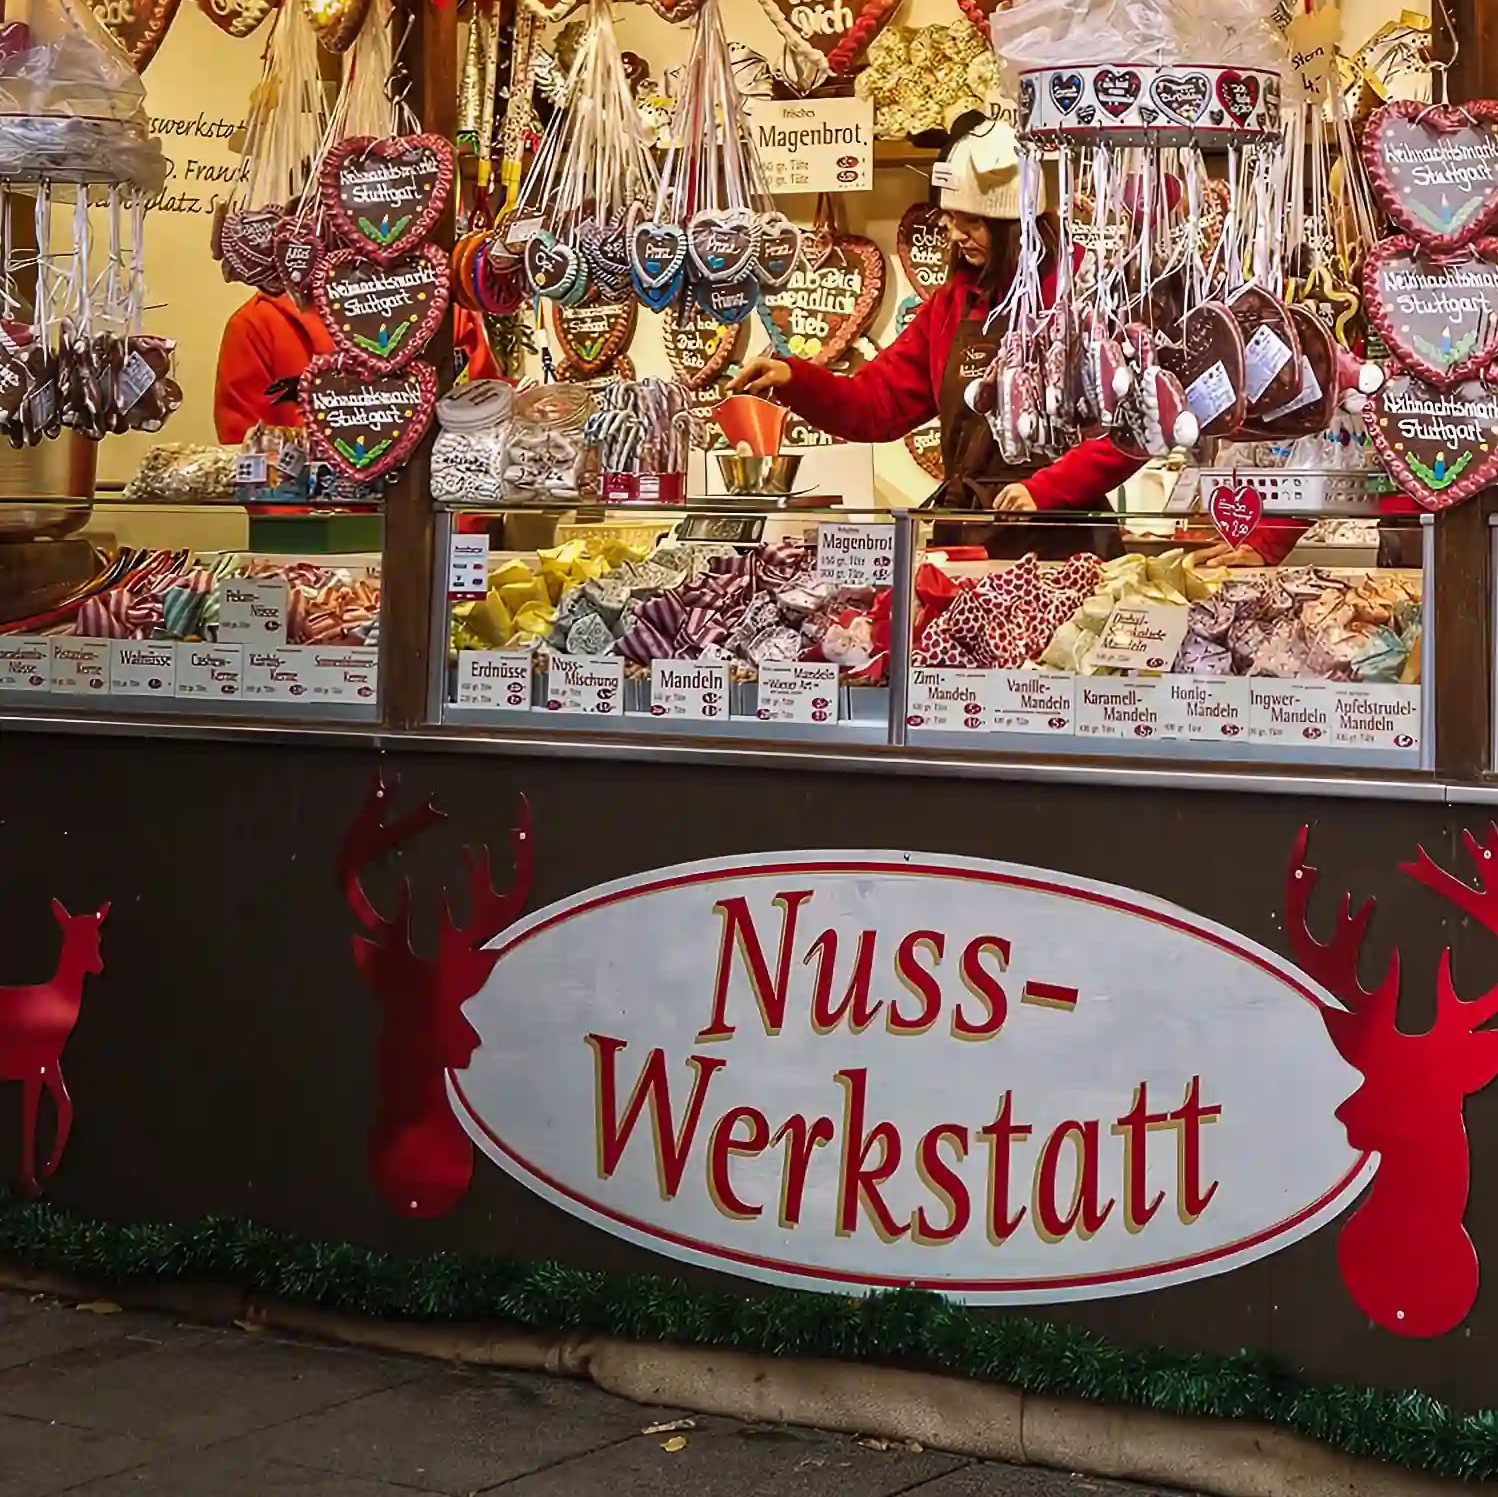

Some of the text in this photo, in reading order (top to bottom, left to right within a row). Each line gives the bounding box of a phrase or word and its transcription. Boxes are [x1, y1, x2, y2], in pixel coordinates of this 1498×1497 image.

[790, 5, 854, 38] Dich
[1411, 161, 1493, 192] Stuttgart
[343, 291, 413, 318] Stuttgart
[1397, 289, 1489, 323] Stuttgart
[326, 409, 405, 432] Stuttgart
[1398, 419, 1486, 450] Stuttgart
[822, 532, 892, 554] Magenbrot
[471, 661, 528, 679] Erdnüsse
[551, 657, 584, 674] Nuss-
[565, 671, 619, 688] Mischung
[660, 669, 723, 690] Mandeln
[913, 670, 946, 686] Zimt-
[1006, 679, 1051, 694] Vanille-
[928, 686, 977, 702] Mandeln
[1021, 694, 1071, 710] Mandeln
[1083, 689, 1143, 706] Karamell-
[1171, 686, 1213, 702] Honig-
[1250, 690, 1301, 708] Ingwer-
[1103, 706, 1158, 723] Mandeln
[1187, 702, 1239, 719] Mandeln
[1271, 707, 1327, 723] Mandeln
[1334, 698, 1418, 717] Apfelstrudel-
[1339, 715, 1395, 732] Mandeln
[694, 888, 1080, 1046] Nuss-
[582, 1031, 1224, 1248] Werkstatt
